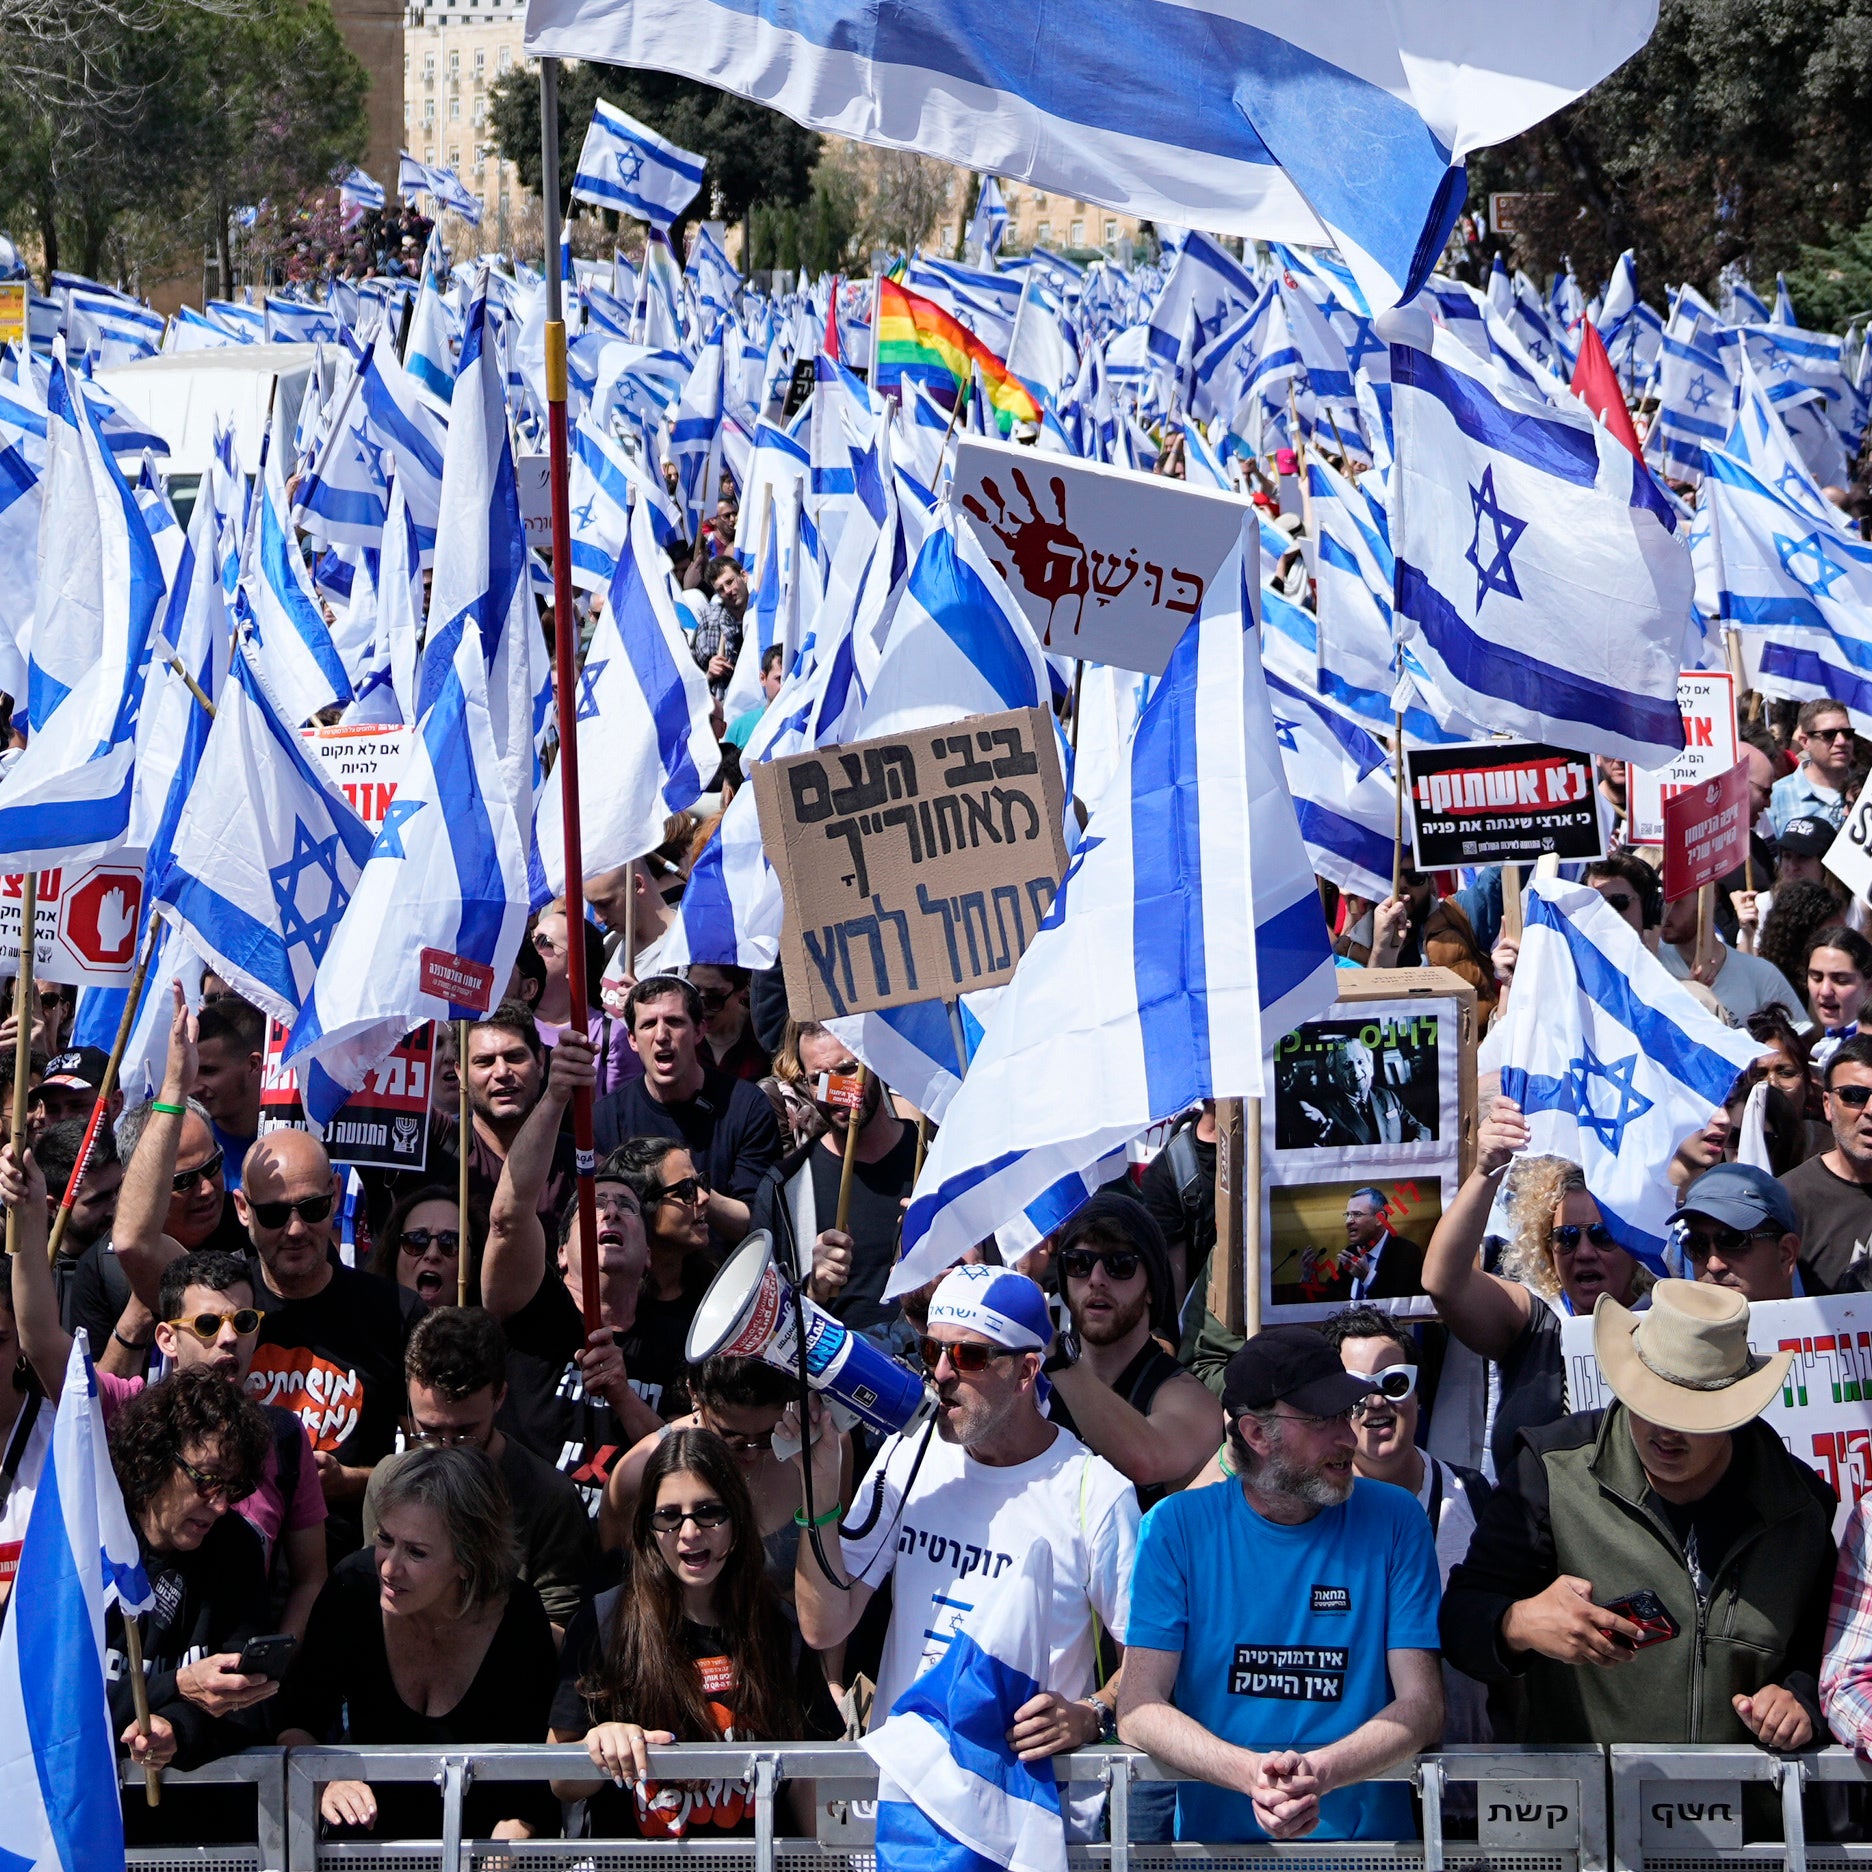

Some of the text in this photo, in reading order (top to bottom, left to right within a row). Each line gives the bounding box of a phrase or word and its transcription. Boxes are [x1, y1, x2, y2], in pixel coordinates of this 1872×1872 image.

[1676, 683, 1710, 695] אם לא
[321, 743, 399, 759] אם לא תקום
[1688, 755, 1704, 763] הם
[341, 761, 377, 774] להיות
[788, 728, 1038, 824] ביבי העם
[1670, 769, 1697, 780] אותך
[1418, 761, 1588, 814] לא אשתוק!
[342, 782, 398, 821] אזר
[1422, 812, 1591, 835] כי ארצי שינתה את פניה
[1685, 802, 1739, 848] איפה הביטחון
[1687, 825, 1737, 866] האישי שלי?
[35, 909, 57, 922] את
[12, 925, 55, 940] האי
[803, 894, 919, 1016] לרוץ
[336, 1121, 388, 1146] התנועה
[928, 1304, 977, 1319] ישראל
[898, 1524, 1013, 1579] מוקרטיה
[1314, 1589, 1346, 1600] מחאת
[1239, 1650, 1343, 1668] אין דמוקרטיה
[1234, 1671, 1338, 1699] אין הייטק
[1487, 1804, 1568, 1829] קשת
